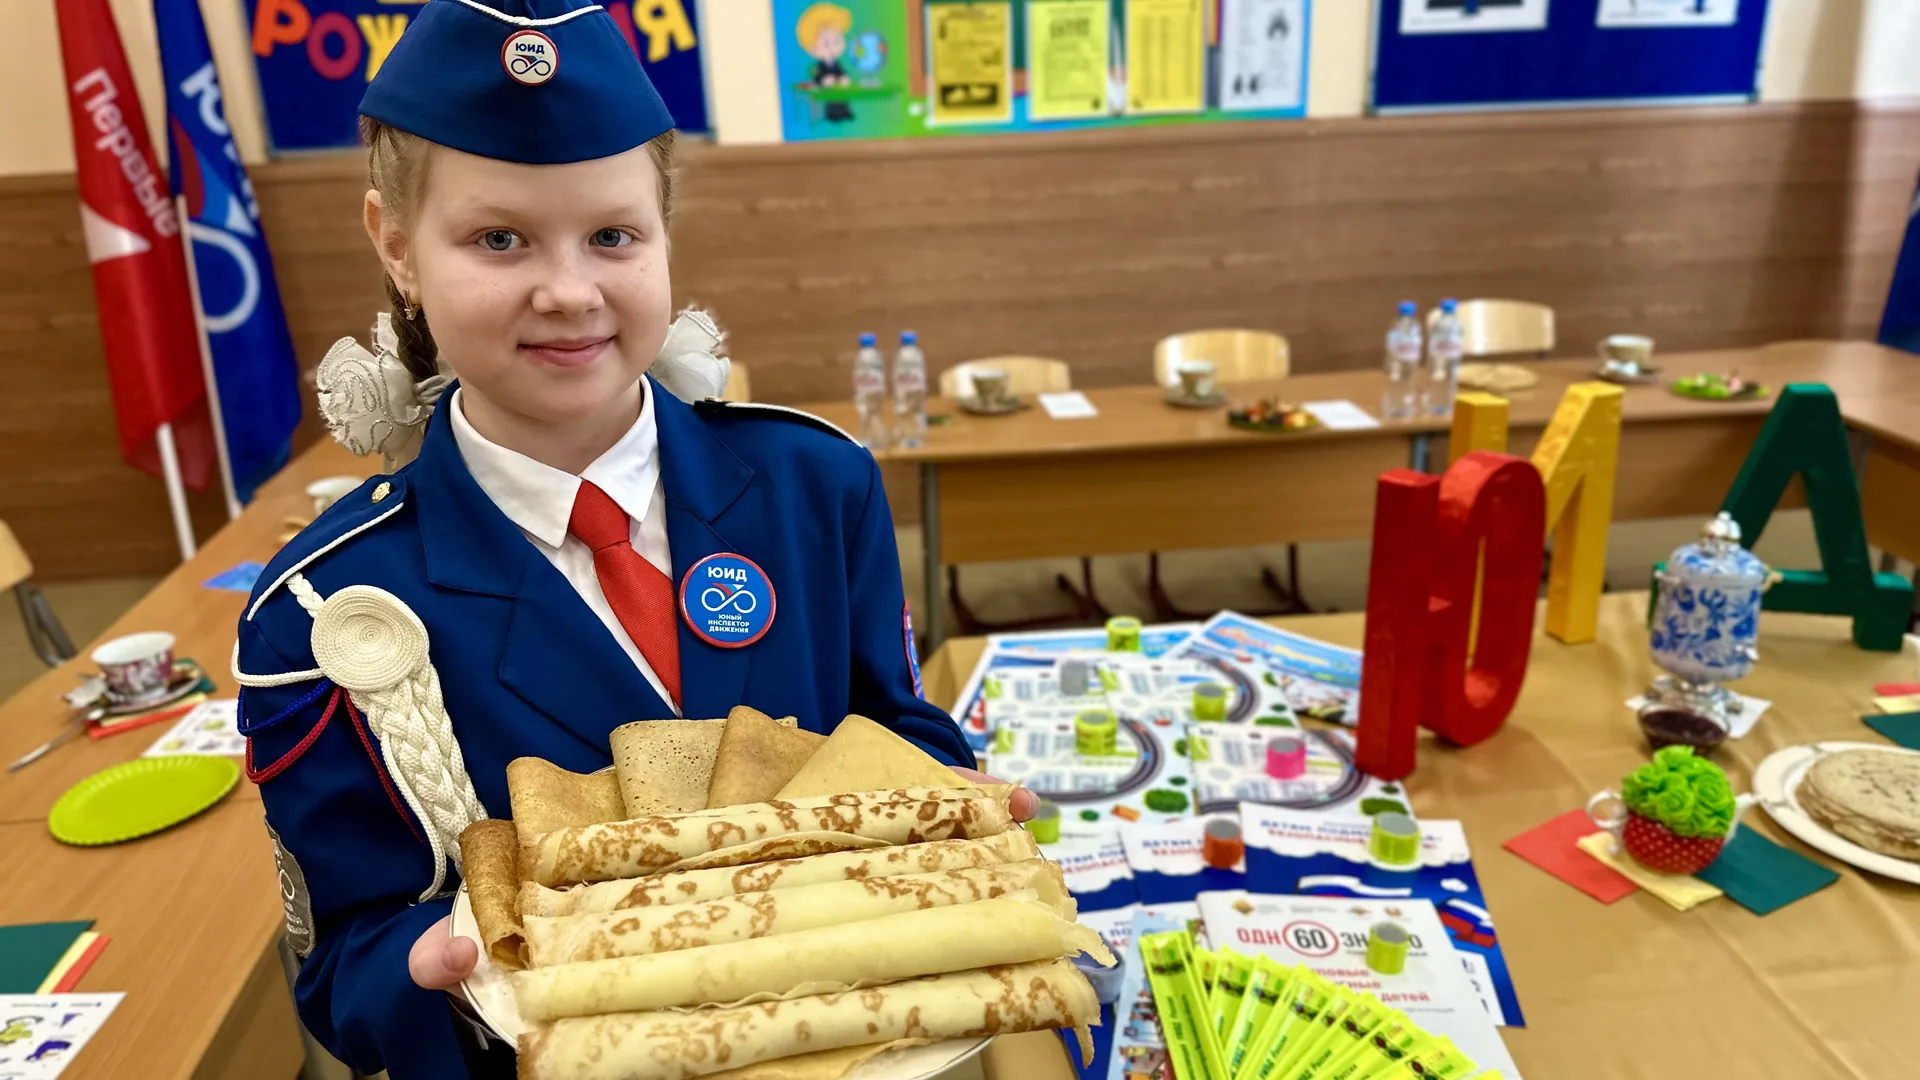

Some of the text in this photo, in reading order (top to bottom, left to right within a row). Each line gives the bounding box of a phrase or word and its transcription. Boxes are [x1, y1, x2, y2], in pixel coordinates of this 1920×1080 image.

[515, 43, 545, 55] ЮИД
[73, 67, 181, 237] Первые
[707, 566, 748, 583] ЮИД
[707, 619, 750, 627] ИНСПЕКТОР
[718, 613, 742, 621] ЮНЫЙ
[708, 625, 749, 634] ДВИЖЕНИЯ
[1293, 928, 1329, 950] 60
